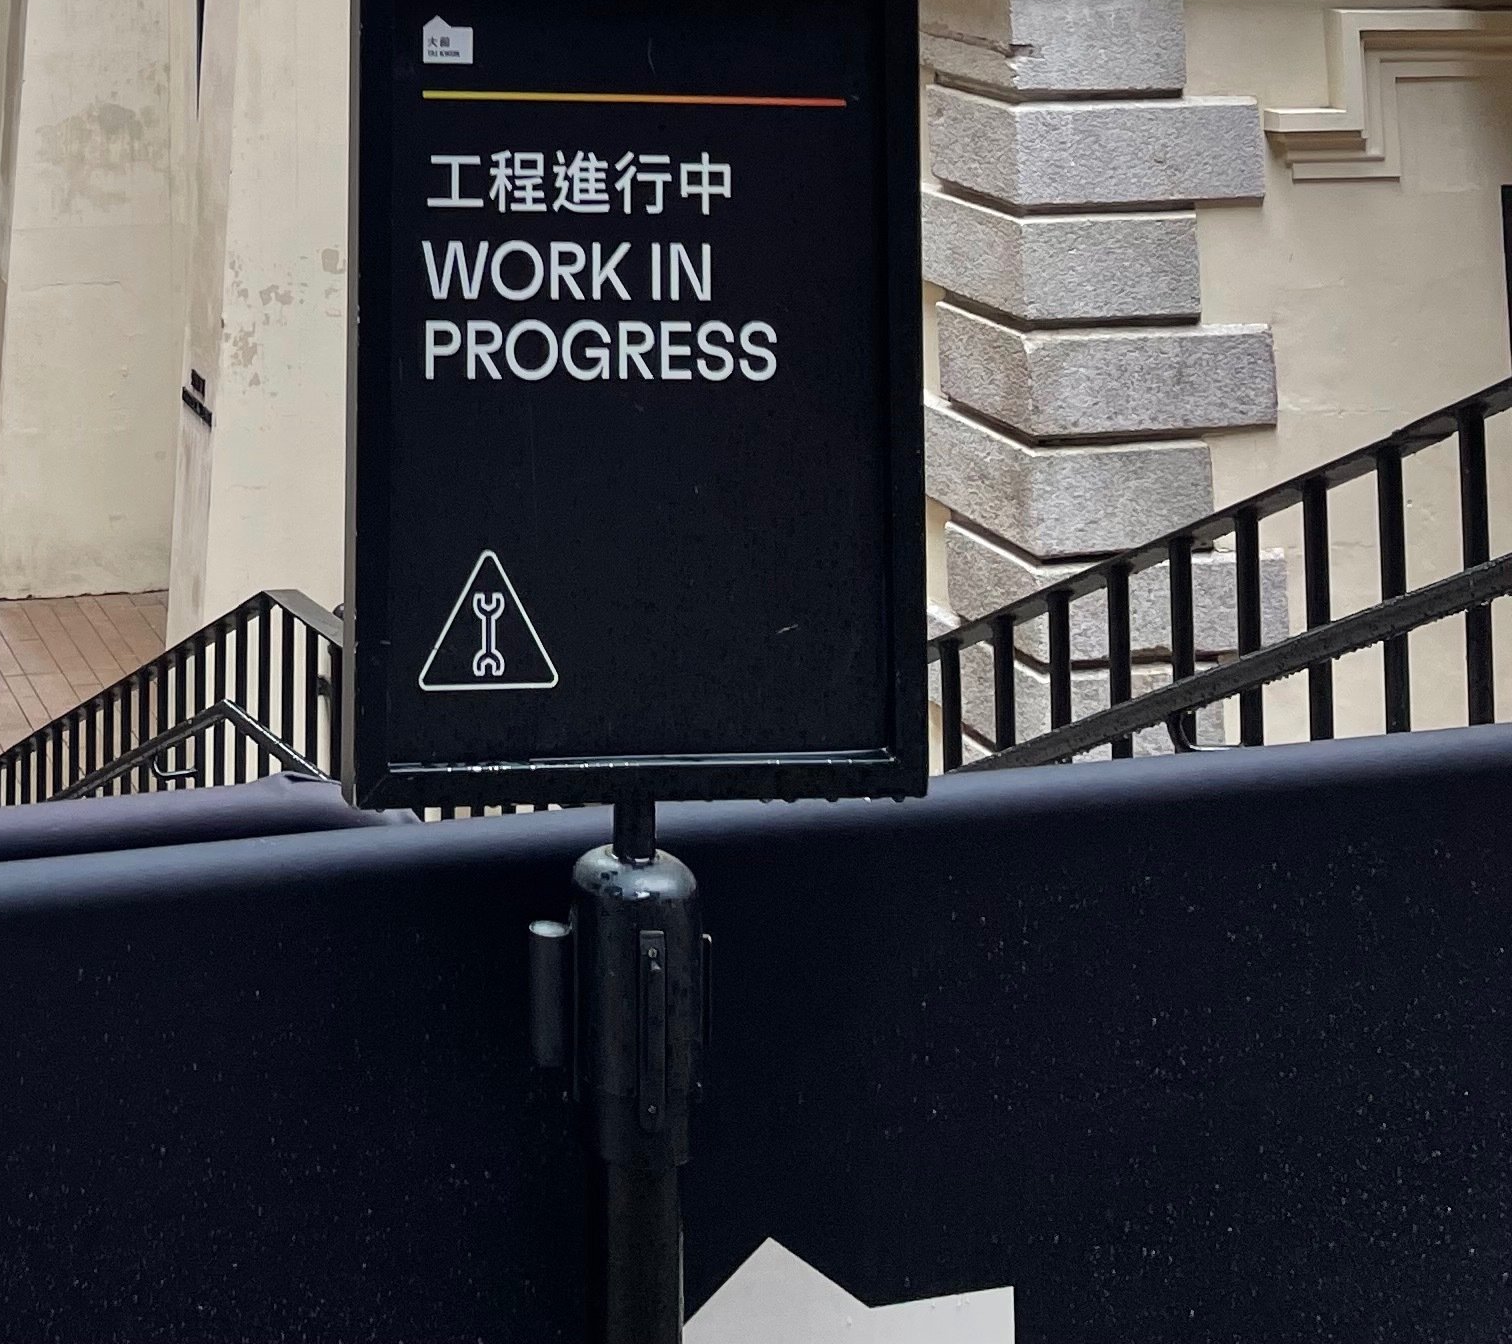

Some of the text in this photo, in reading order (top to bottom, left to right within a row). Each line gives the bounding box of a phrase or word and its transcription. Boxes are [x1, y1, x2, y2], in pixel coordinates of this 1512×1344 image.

[426, 149, 732, 215] 工程進行中
[421, 239, 712, 301] WORK IN
[424, 318, 778, 382] PROGRESS
